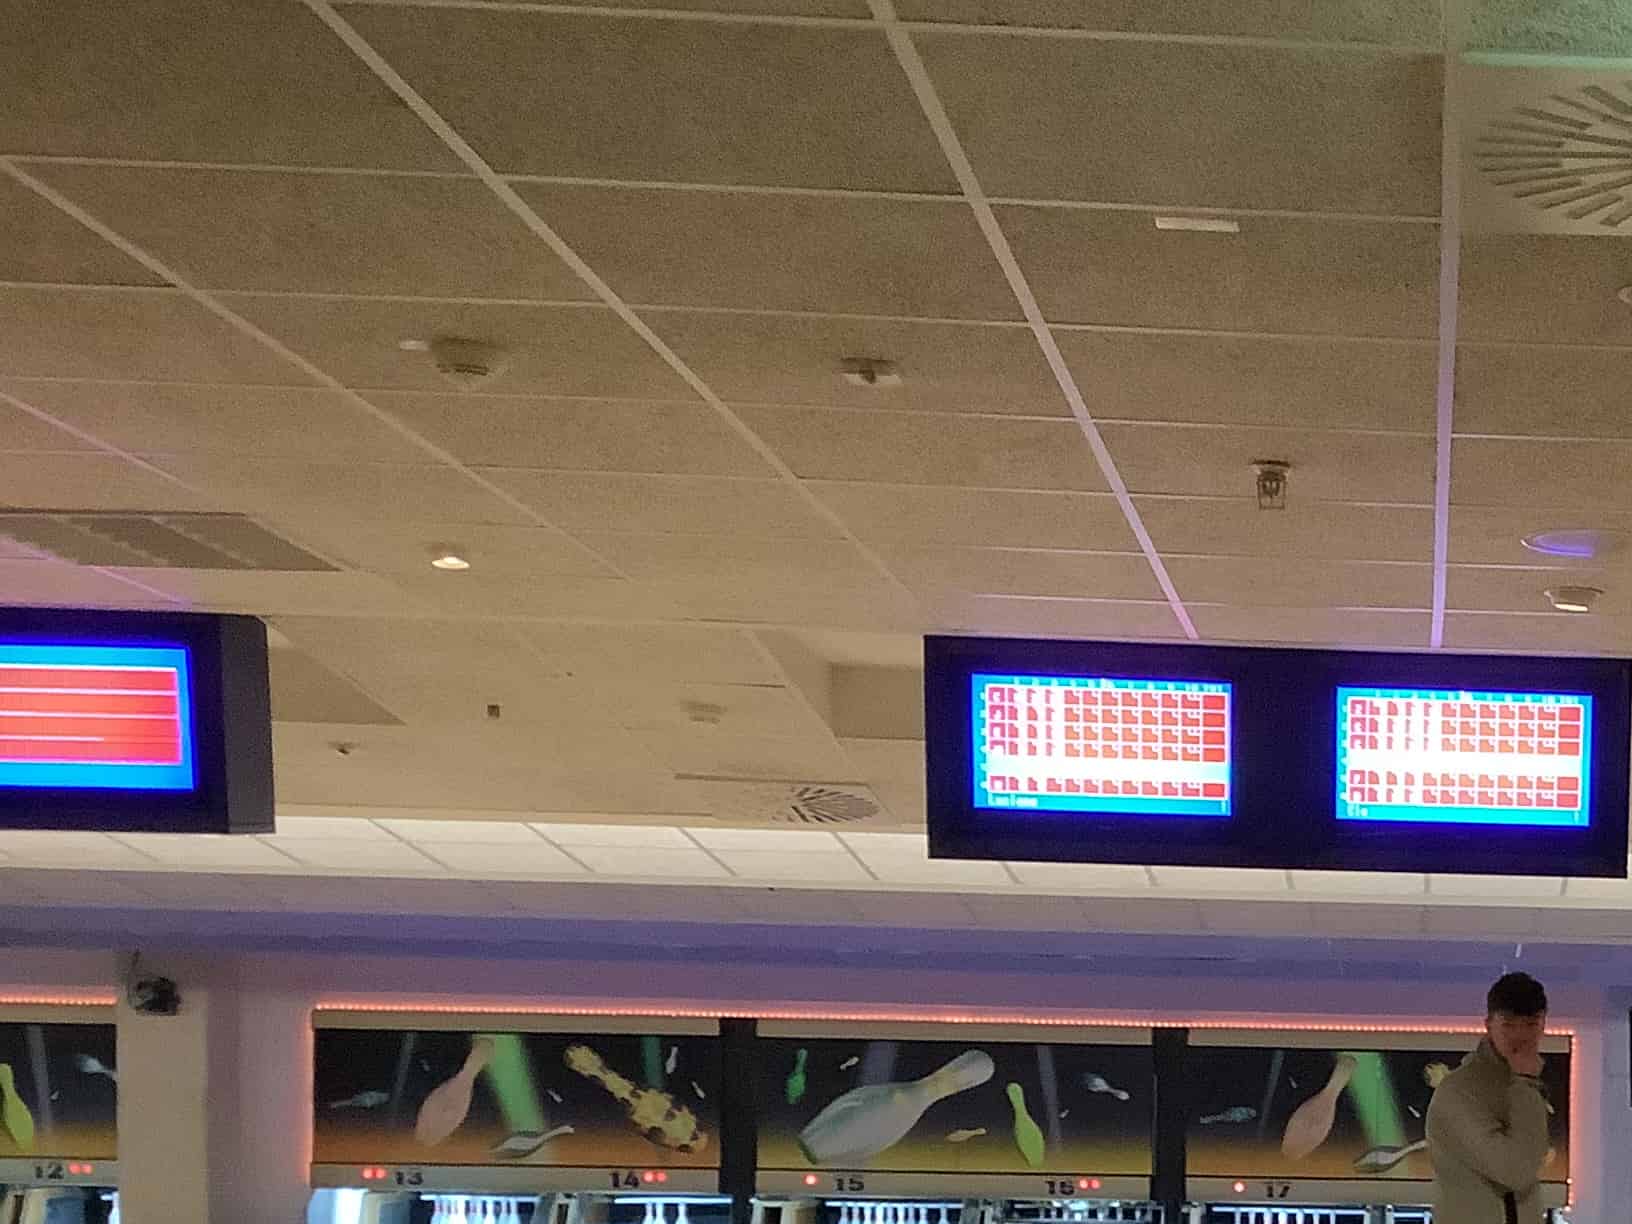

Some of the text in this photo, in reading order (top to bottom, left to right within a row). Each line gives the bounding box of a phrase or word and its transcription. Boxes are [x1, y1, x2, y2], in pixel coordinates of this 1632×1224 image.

[35, 1162, 64, 1179] 12
[394, 1169, 424, 1185] 13
[609, 1169, 640, 1188] 14
[835, 1177, 865, 1192] 15
[1045, 1180, 1075, 1196] 16
[1264, 1181, 1293, 1198] 17
